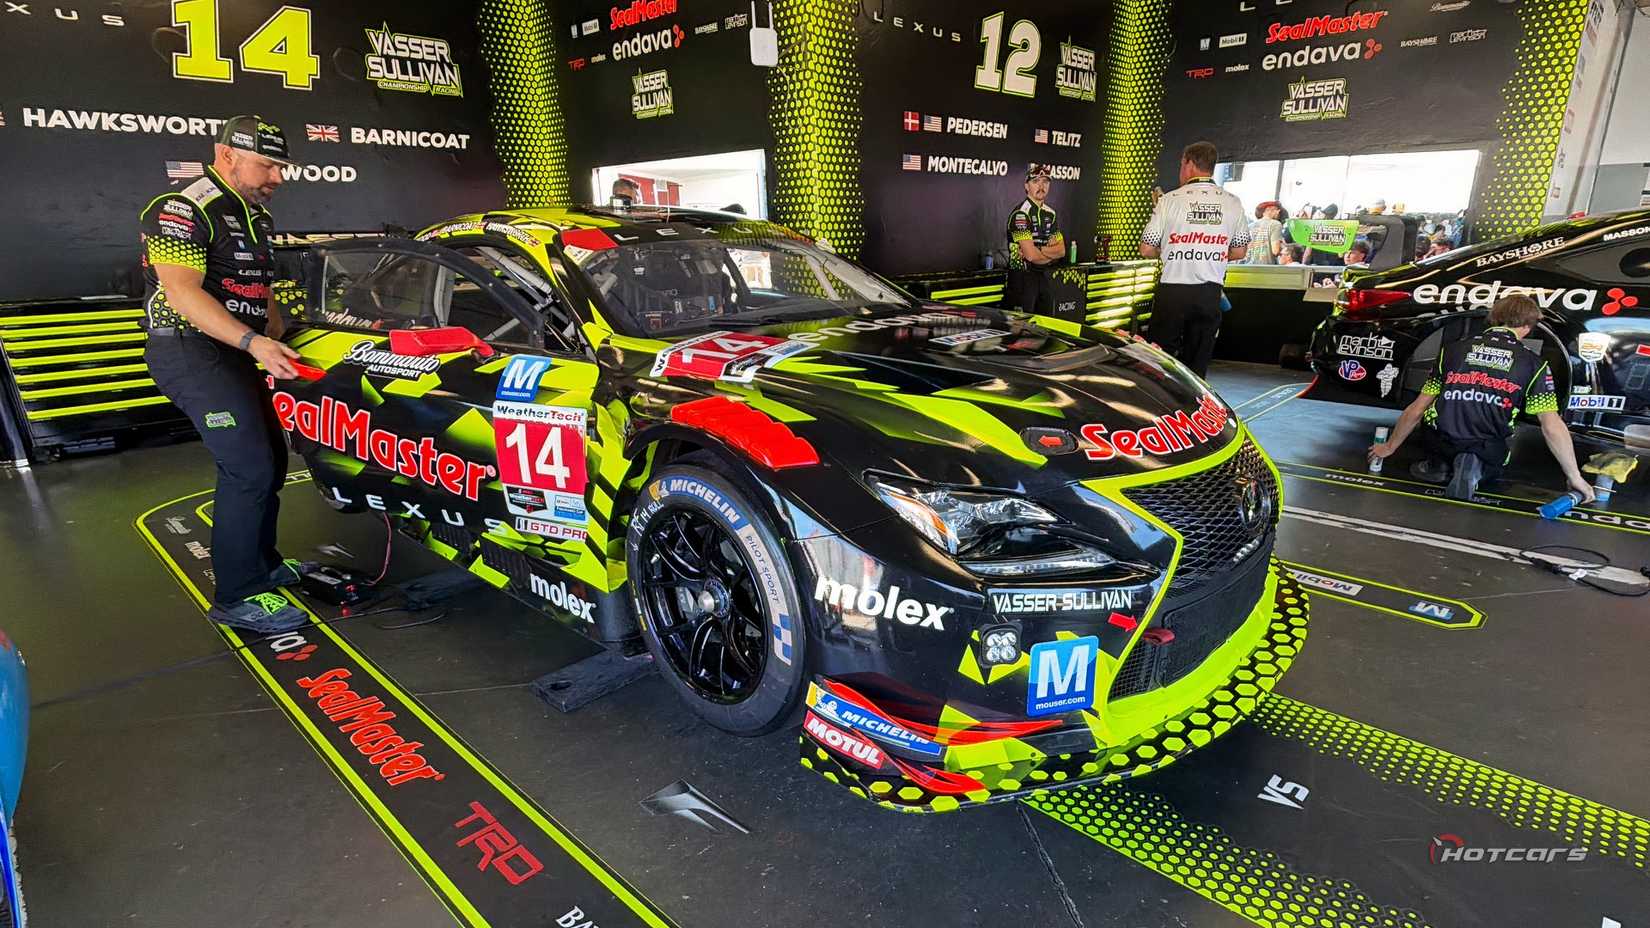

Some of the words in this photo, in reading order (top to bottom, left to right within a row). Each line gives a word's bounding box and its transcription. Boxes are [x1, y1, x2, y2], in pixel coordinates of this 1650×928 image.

[873, 11, 961, 42] LEXUS
[1266, 11, 1384, 44] SealMaster
[171, 0, 320, 91] 14
[368, 30, 451, 63] VASSER
[612, 29, 672, 60] endava
[974, 11, 1042, 98] 12
[1060, 43, 1095, 70] VASSER
[1262, 42, 1361, 71] endava
[367, 55, 459, 86] SULLIVAN
[1057, 66, 1097, 91] SULLIVAN
[1225, 64, 1249, 73] molex
[633, 75, 668, 93] VASSER
[1291, 79, 1344, 99] VASSER
[632, 90, 671, 111] SULLIVAN
[1283, 95, 1347, 115] SULLIVAN
[351, 127, 470, 149] BARNICOAT
[947, 116, 1008, 139] PEDERSEN
[1052, 130, 1081, 147] TELITZ
[927, 156, 1008, 176] MONTECALVO
[1168, 232, 1228, 245] SealMaste
[1476, 237, 1566, 267] BAYSHORE
[1167, 249, 1221, 261] endava
[682, 338, 770, 364] 14
[1467, 353, 1513, 368] SULLIVAN
[1472, 344, 1513, 358] VASSER
[367, 365, 422, 377] AUTOSPORT
[503, 359, 546, 390] M
[497, 405, 582, 422] WeatherTech
[1569, 396, 1605, 406] Mobil
[1612, 398, 1618, 408] 1
[265, 375, 489, 501] ealMaster
[505, 423, 571, 489] 14
[331, 486, 505, 532] LEXUS
[671, 479, 740, 523] MICHELIN
[530, 522, 559, 535] GTD
[746, 535, 766, 564] PILOT
[762, 566, 779, 601] SPORT
[530, 572, 594, 624] molex
[815, 576, 950, 630] molex
[993, 593, 1057, 614] VASSER
[1062, 590, 1132, 610] SULLIVAN
[1037, 644, 1090, 699] M
[1035, 696, 1086, 710] mouser.com
[296, 668, 440, 786] SealMaster
[807, 717, 881, 765] MOTUL
[841, 710, 930, 744] MICHELIN
[1257, 774, 1310, 810] VS
[454, 801, 545, 885] TRD
